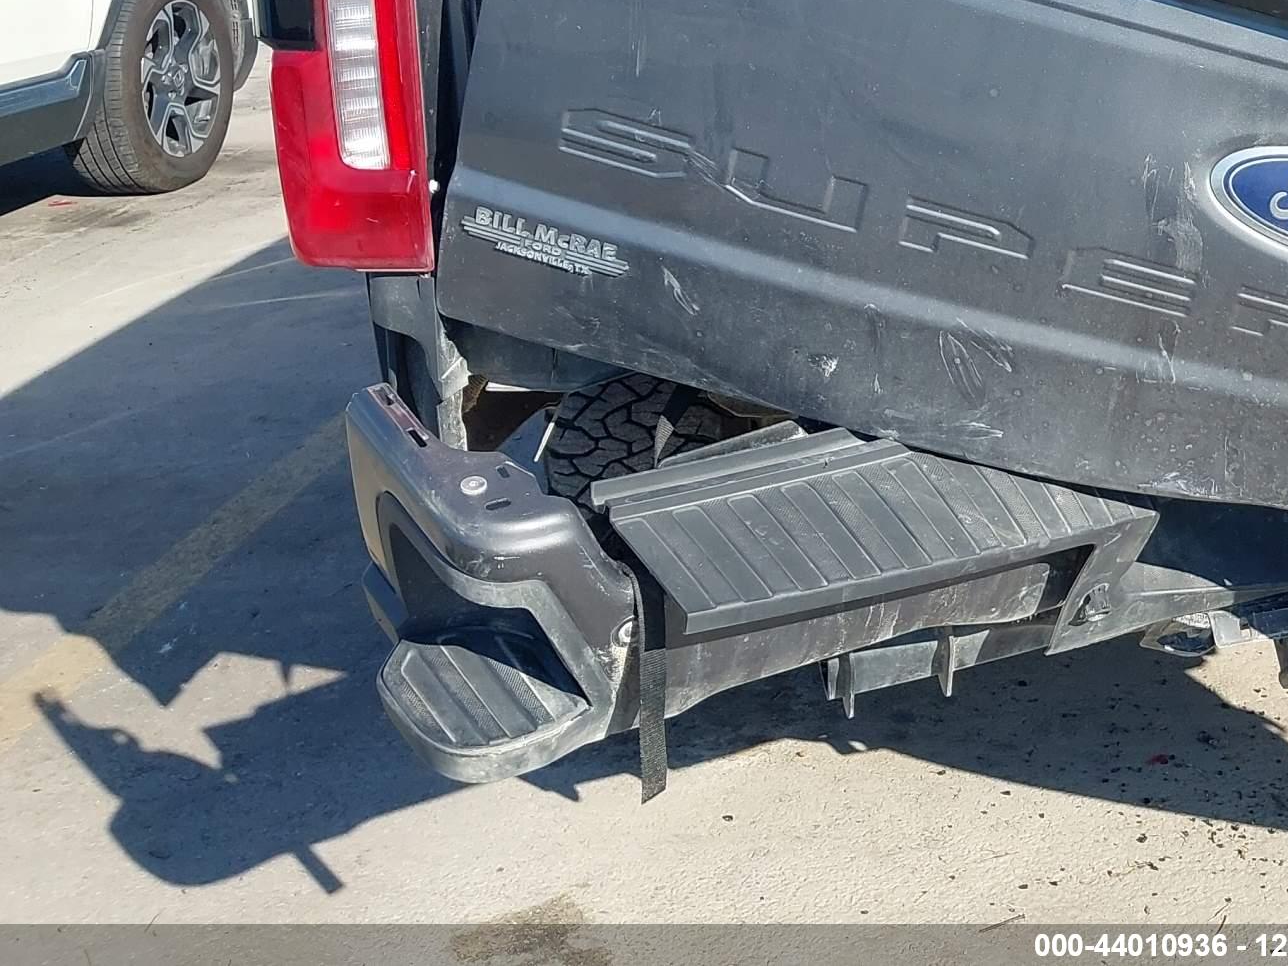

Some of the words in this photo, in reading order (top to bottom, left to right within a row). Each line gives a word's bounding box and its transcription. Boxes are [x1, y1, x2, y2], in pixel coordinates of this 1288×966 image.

[475, 206, 531, 237] BILL
[535, 223, 618, 261] McRAE
[524, 240, 562, 256] FORD
[574, 263, 593, 275] TX
